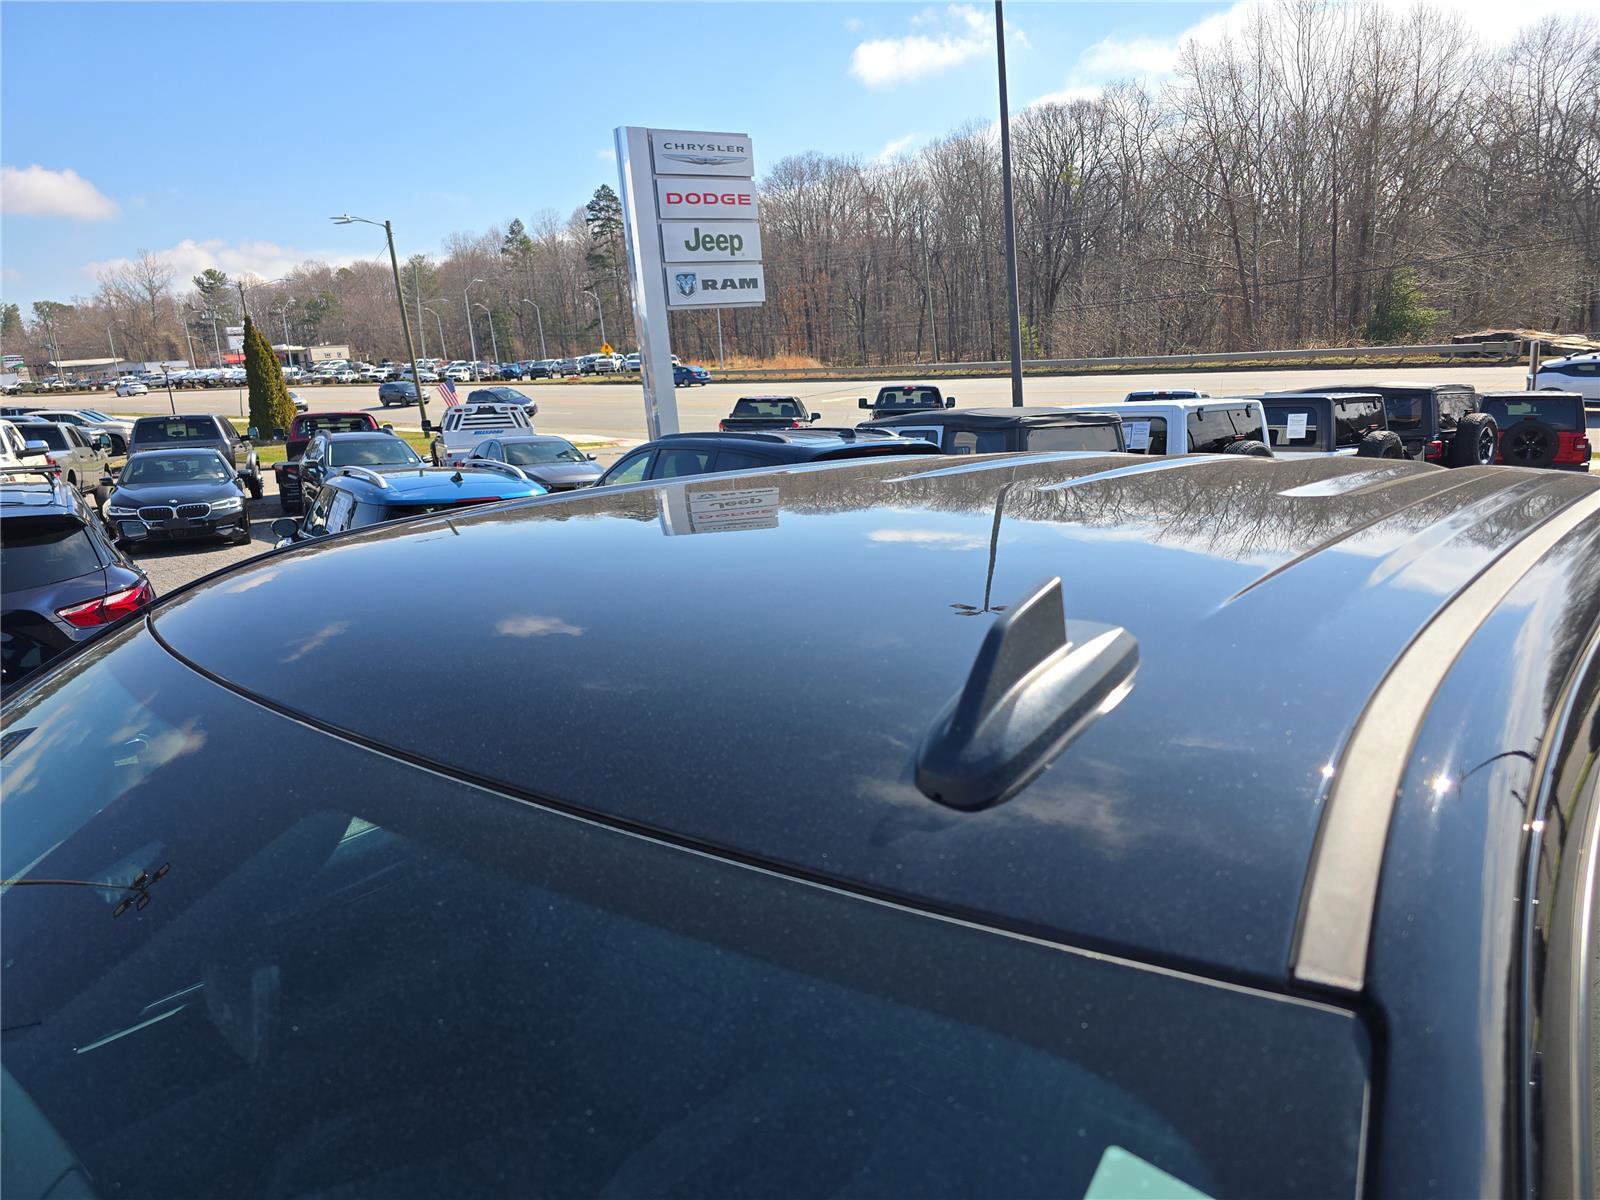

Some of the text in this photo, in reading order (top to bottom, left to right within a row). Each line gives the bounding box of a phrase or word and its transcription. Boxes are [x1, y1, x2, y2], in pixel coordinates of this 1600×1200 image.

[663, 143, 745, 153] CHRYSLER
[666, 192, 751, 205] DODGE
[684, 227, 743, 256] Jeep
[701, 278, 759, 291] RAM
